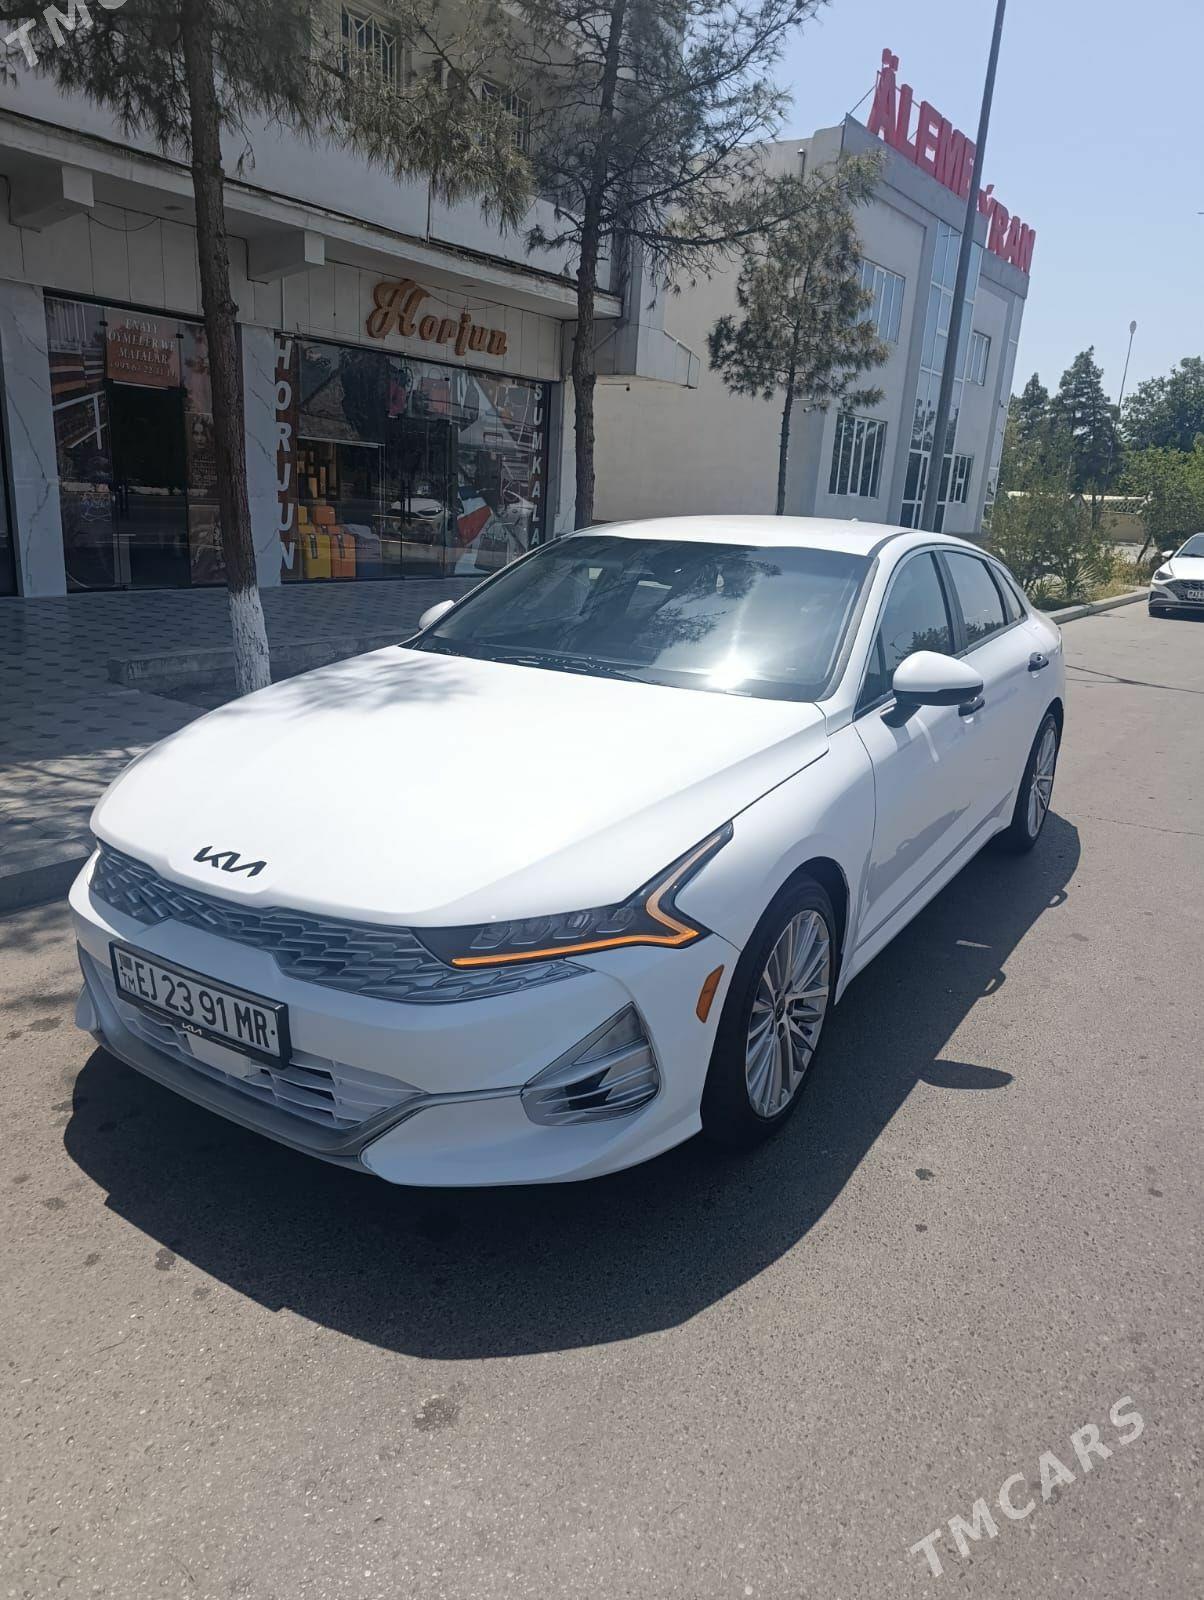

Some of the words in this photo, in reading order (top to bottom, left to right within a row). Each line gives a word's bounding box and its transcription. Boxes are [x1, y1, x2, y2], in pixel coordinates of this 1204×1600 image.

[366, 279, 508, 356] Horjun
[275, 336, 297, 570] HORJUN
[121, 972, 137, 993] TM
[135, 961, 158, 1001] EJ
[161, 974, 194, 1017] 23
[198, 990, 229, 1033] 91
[234, 1002, 270, 1049] MR
